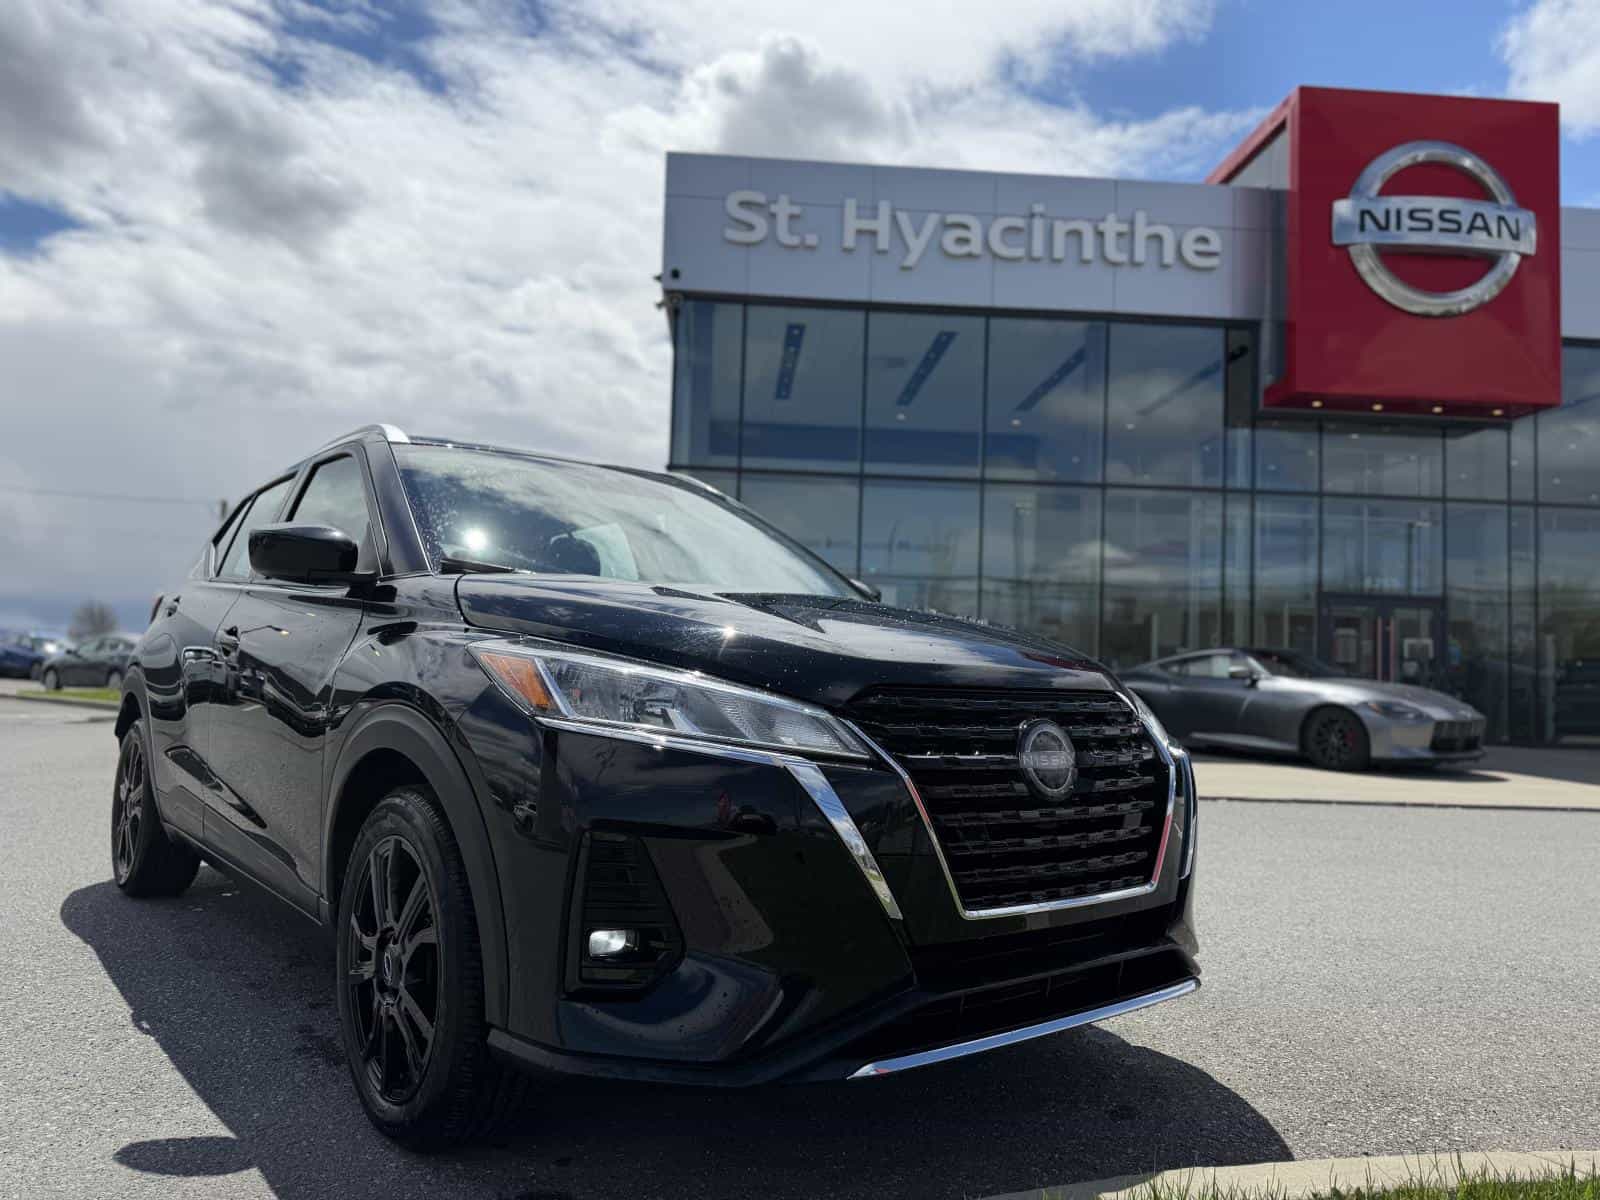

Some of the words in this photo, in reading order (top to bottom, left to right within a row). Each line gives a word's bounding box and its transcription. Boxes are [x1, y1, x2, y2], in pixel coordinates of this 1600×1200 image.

[724, 190, 819, 248] St.
[842, 199, 1223, 268] Hyacinthe
[1359, 208, 1521, 241] NISSAN
